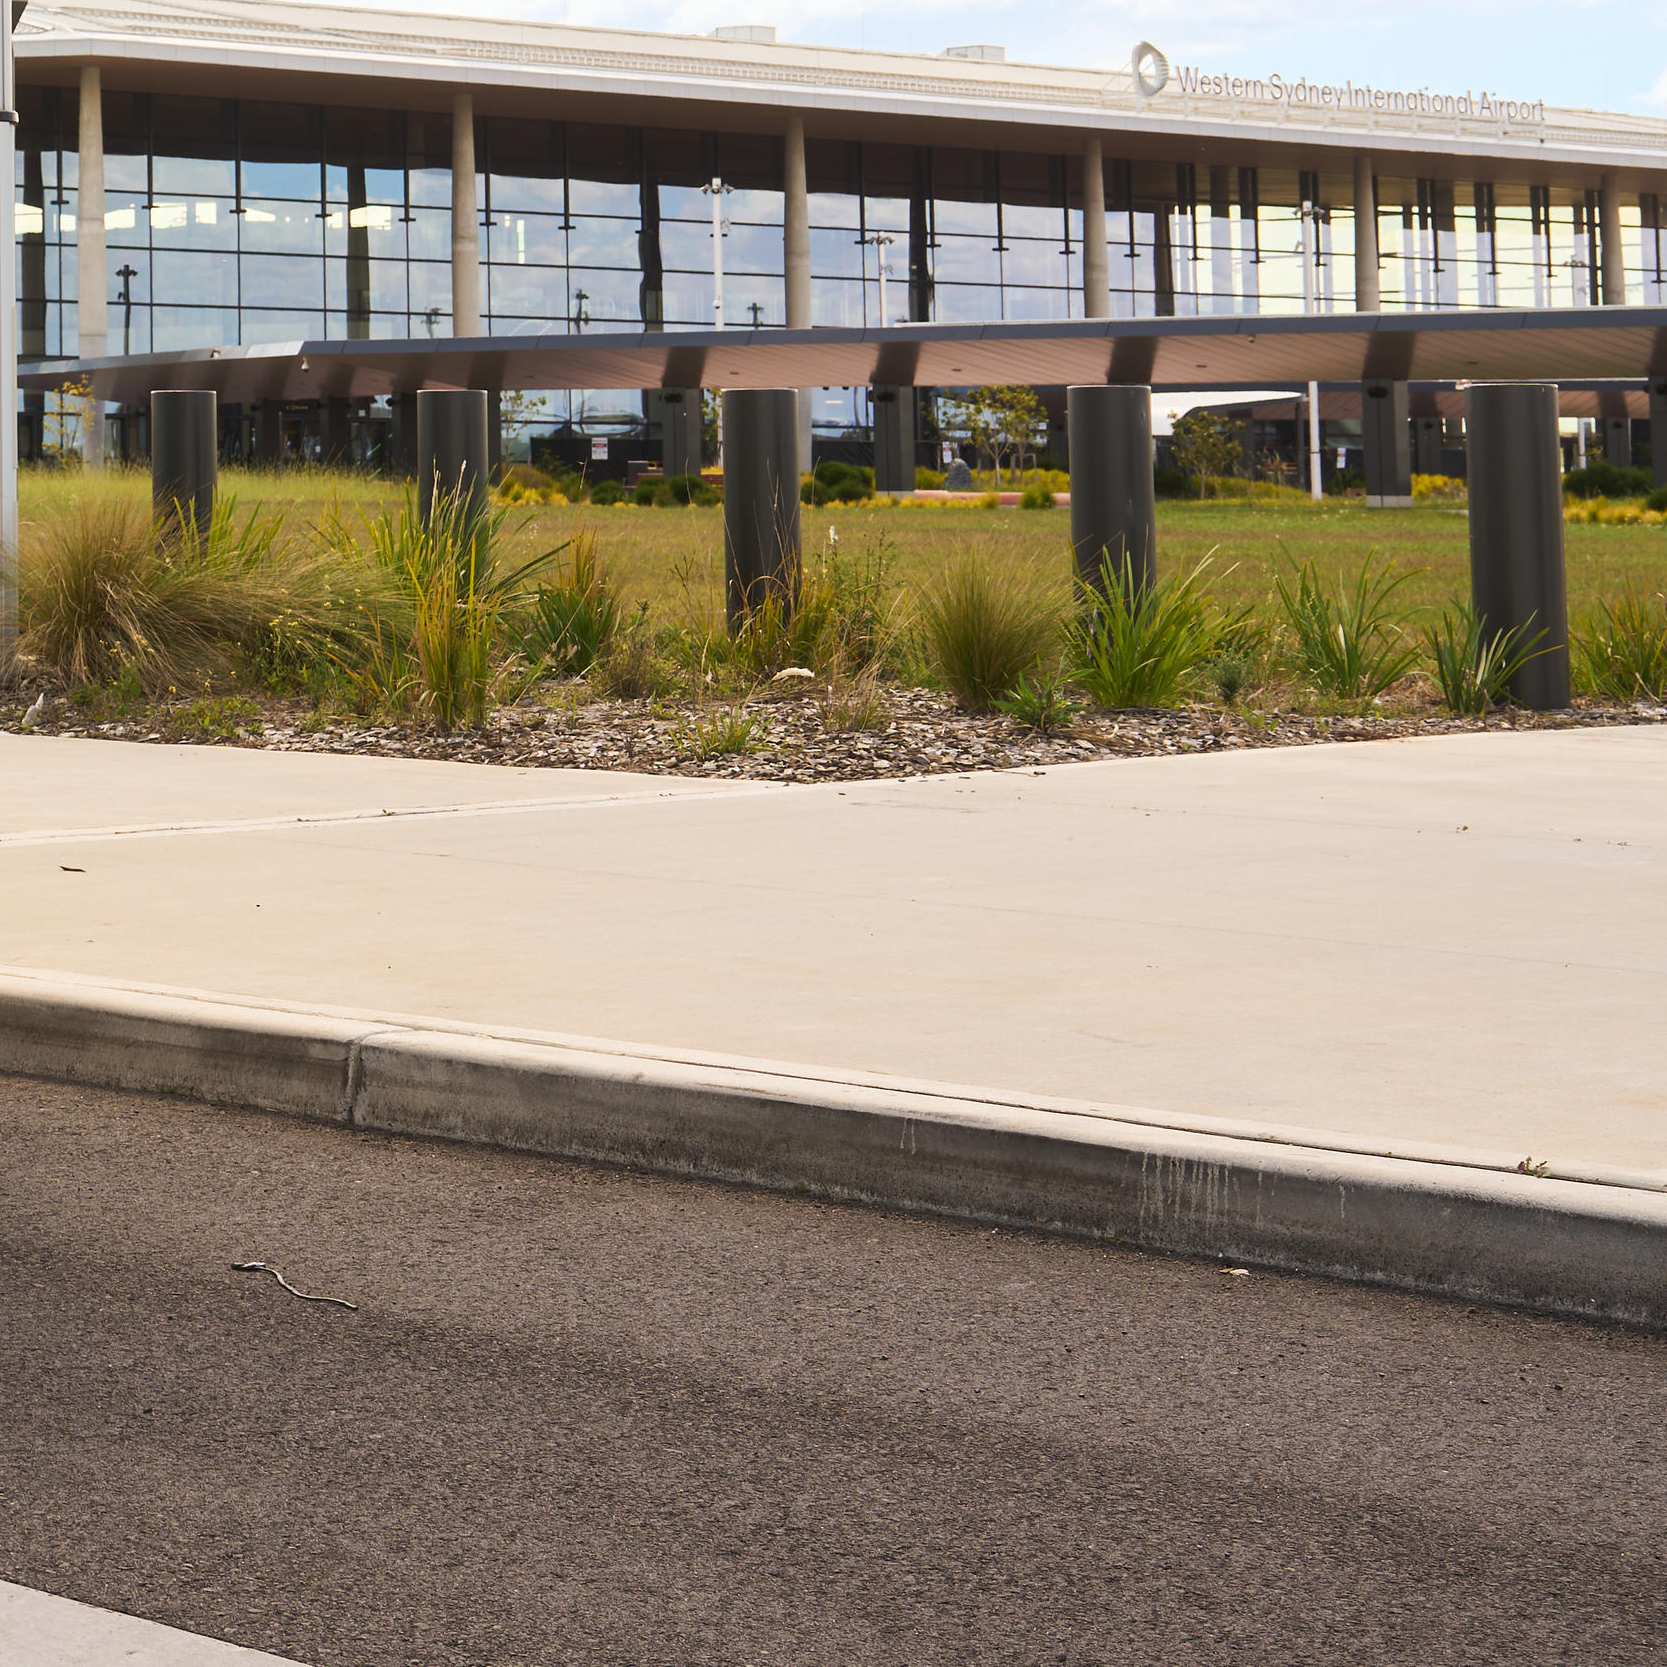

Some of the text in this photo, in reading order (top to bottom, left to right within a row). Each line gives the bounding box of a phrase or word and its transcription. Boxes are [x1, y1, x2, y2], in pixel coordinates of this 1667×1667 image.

[1175, 65, 1546, 125] Western Sydney International Airport
